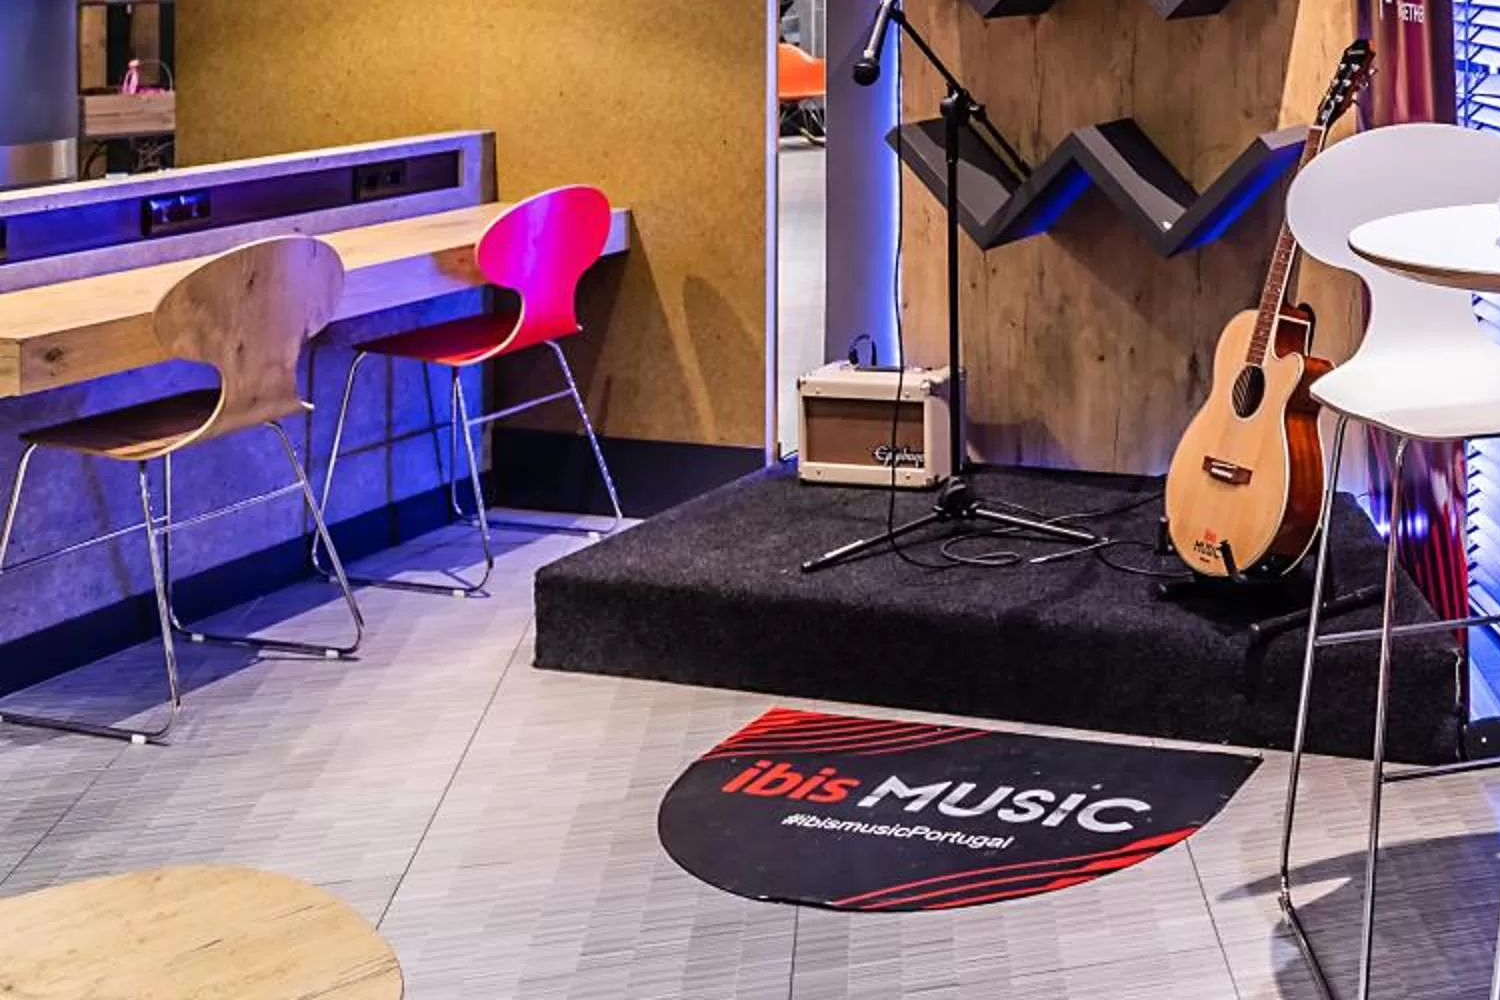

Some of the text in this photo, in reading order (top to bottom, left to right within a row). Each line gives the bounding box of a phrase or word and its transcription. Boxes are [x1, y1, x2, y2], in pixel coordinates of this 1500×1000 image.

[721, 759, 1152, 833] ibis MUSIC
[781, 812, 1014, 850] #ibismusicPortugal
